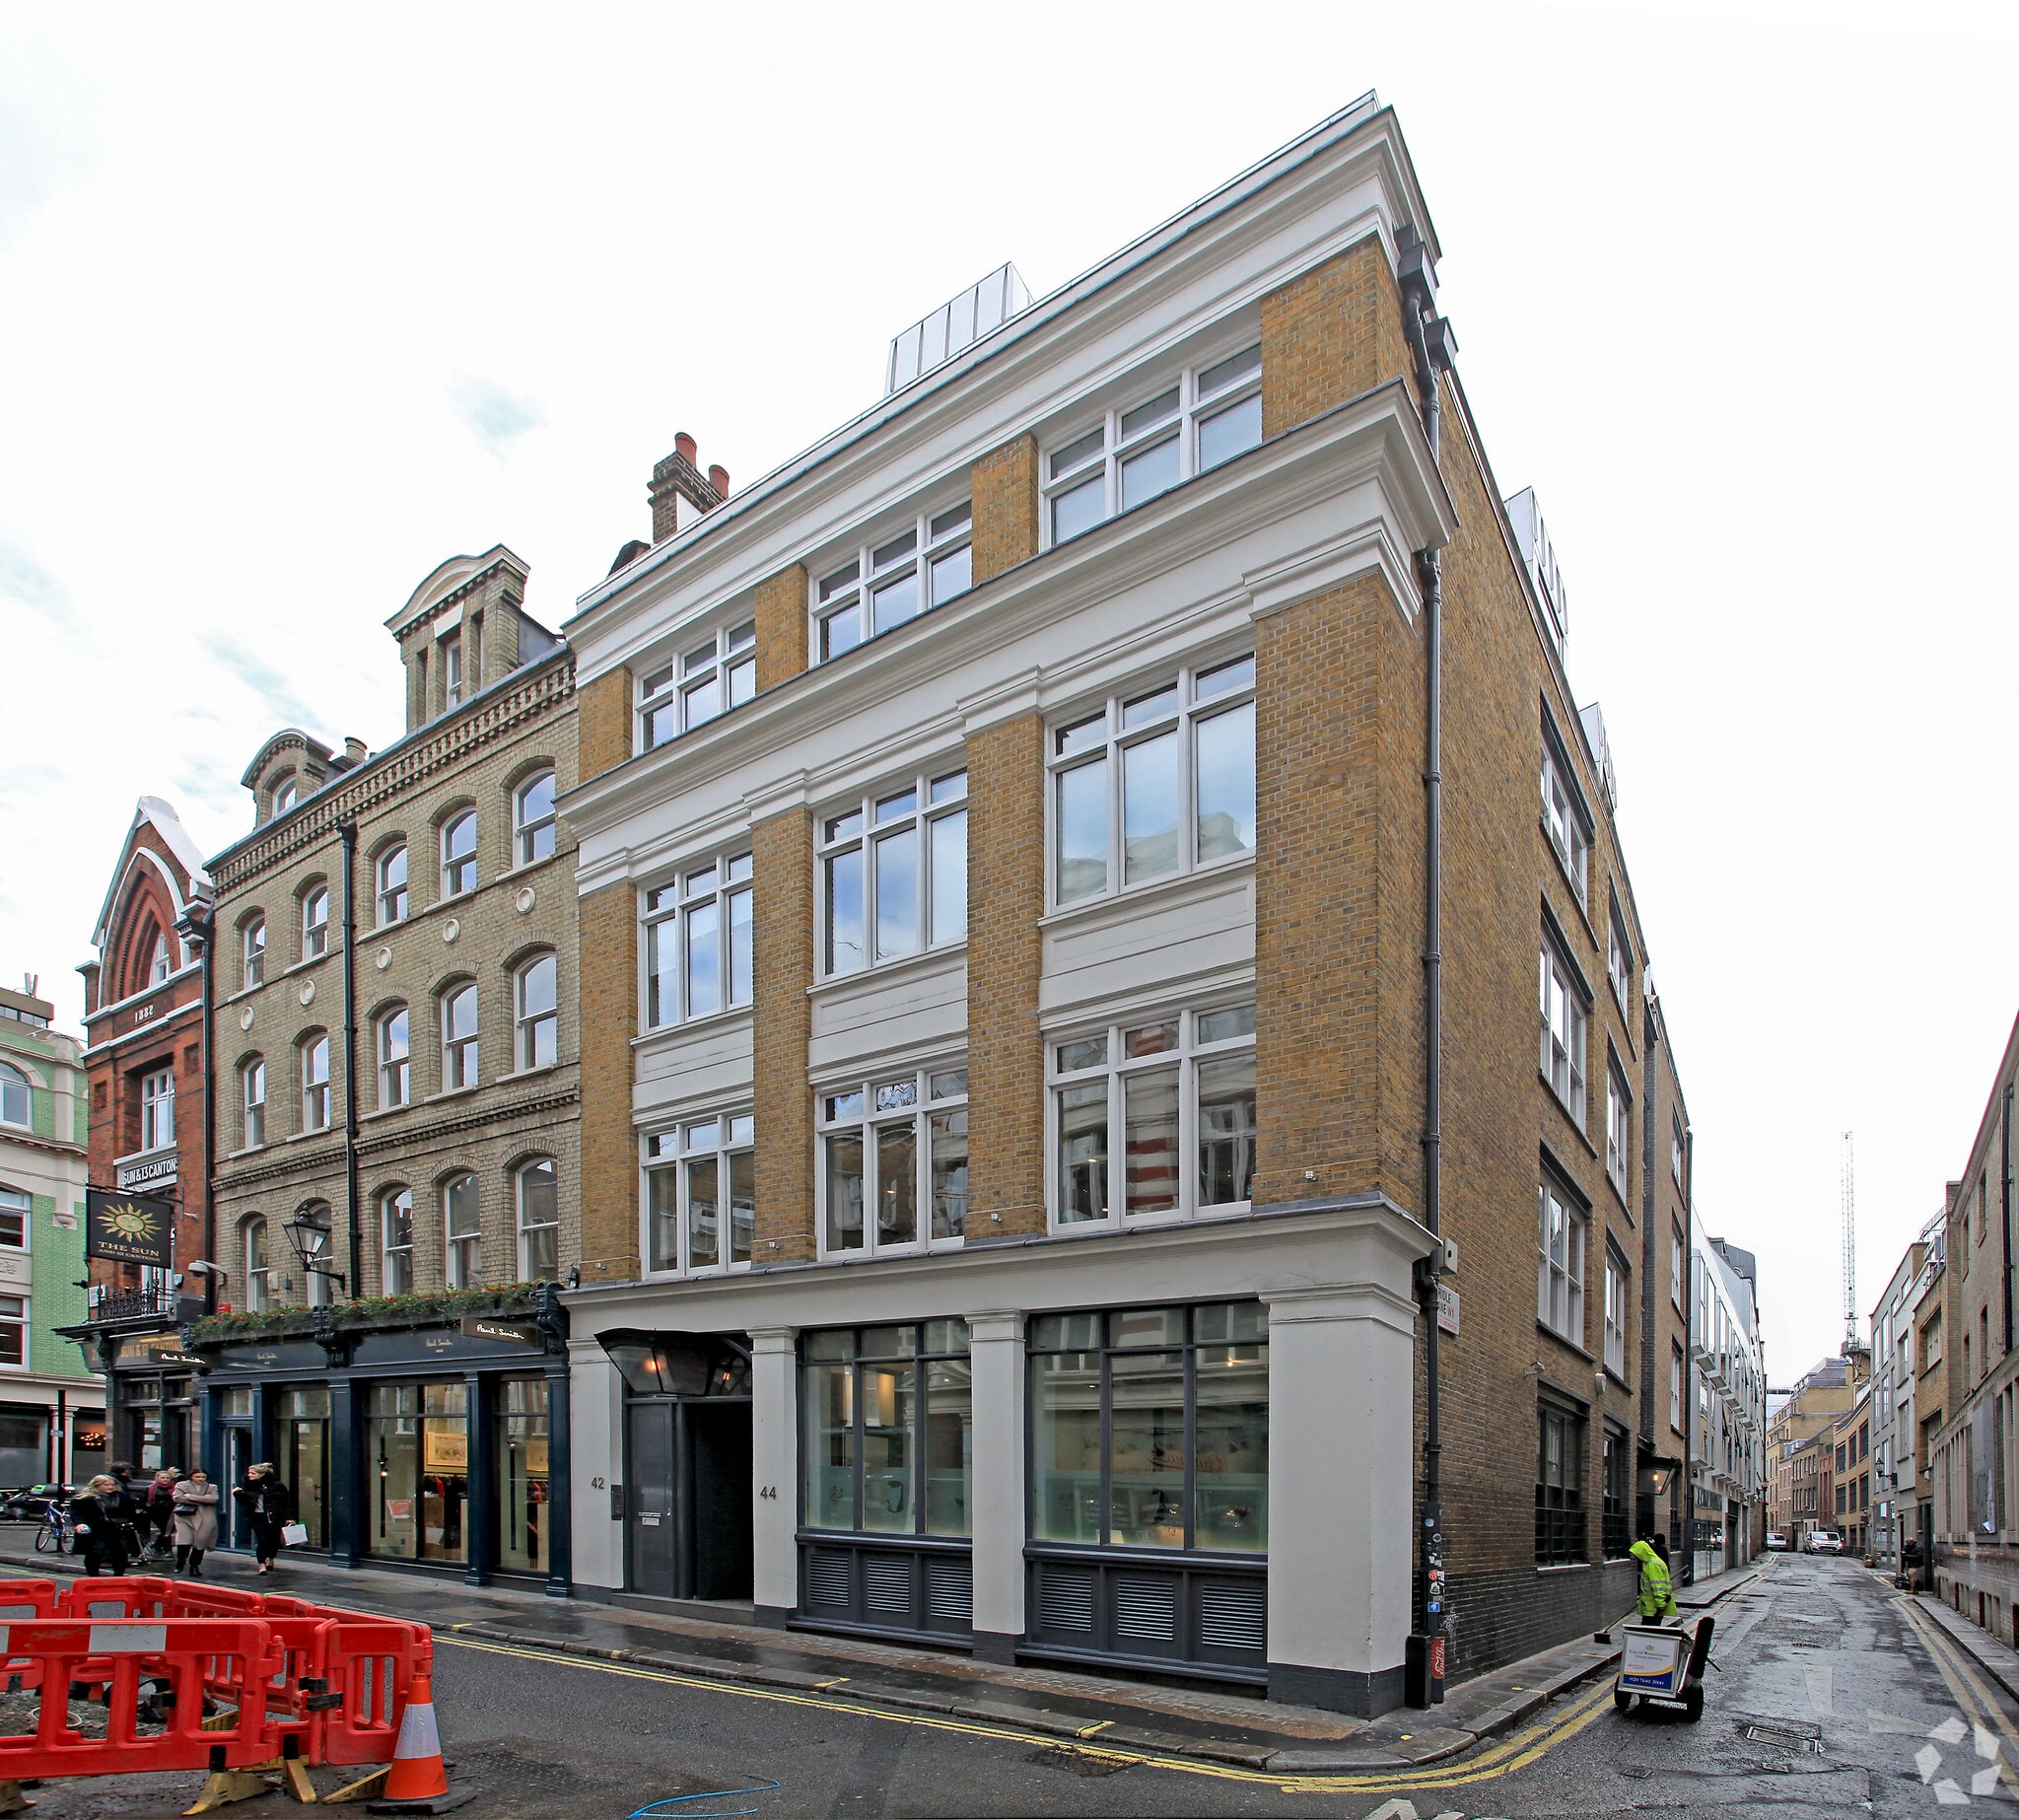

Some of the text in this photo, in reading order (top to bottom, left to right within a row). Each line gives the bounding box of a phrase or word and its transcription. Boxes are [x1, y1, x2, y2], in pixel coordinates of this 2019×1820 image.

[134, 1005, 154, 1022] 1882
[148, 1157, 177, 1178] CANTON
[98, 1241, 160, 1257] THE SUN
[476, 1323, 524, 1340] Paul Smith
[120, 1343, 134, 1358] SUN
[161, 1353, 206, 1365] Paul Smith
[592, 1477, 604, 1490] 42
[760, 1486, 777, 1500] 44
